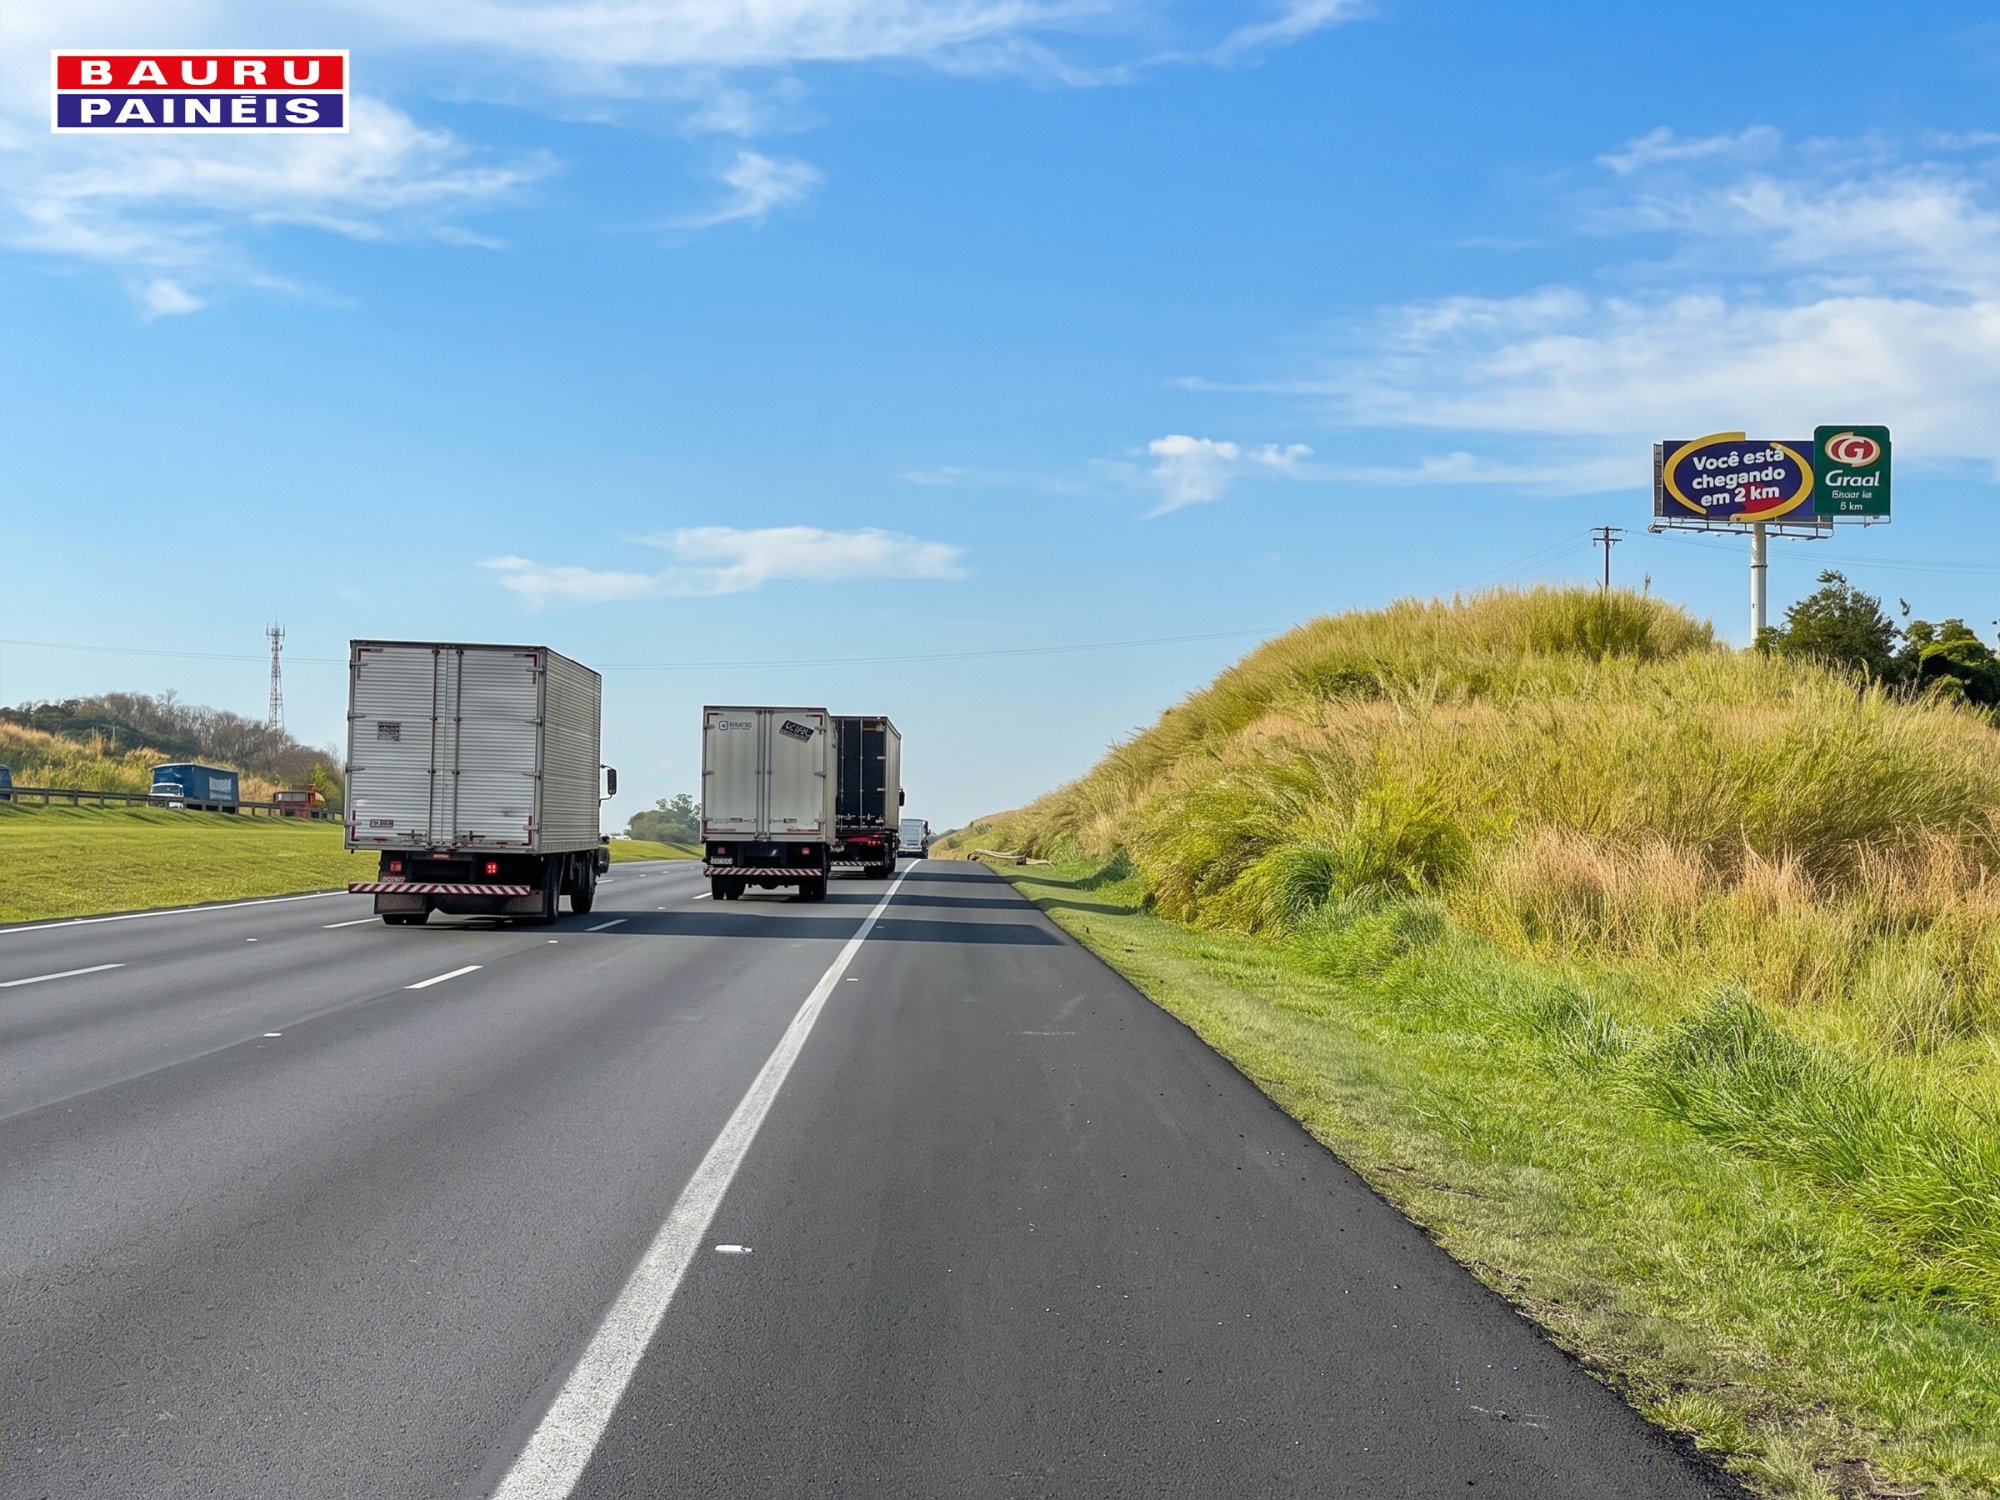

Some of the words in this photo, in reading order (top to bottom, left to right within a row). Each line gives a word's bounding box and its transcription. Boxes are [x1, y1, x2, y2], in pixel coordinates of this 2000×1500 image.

[1692, 451, 1740, 471] Você
[1692, 466, 1786, 490] chegando
[1825, 470, 1880, 487] Graal
[1700, 492, 1730, 507] em
[1734, 487, 1746, 503] 2
[1750, 486, 1780, 501] km
[1849, 502, 1863, 511] km
